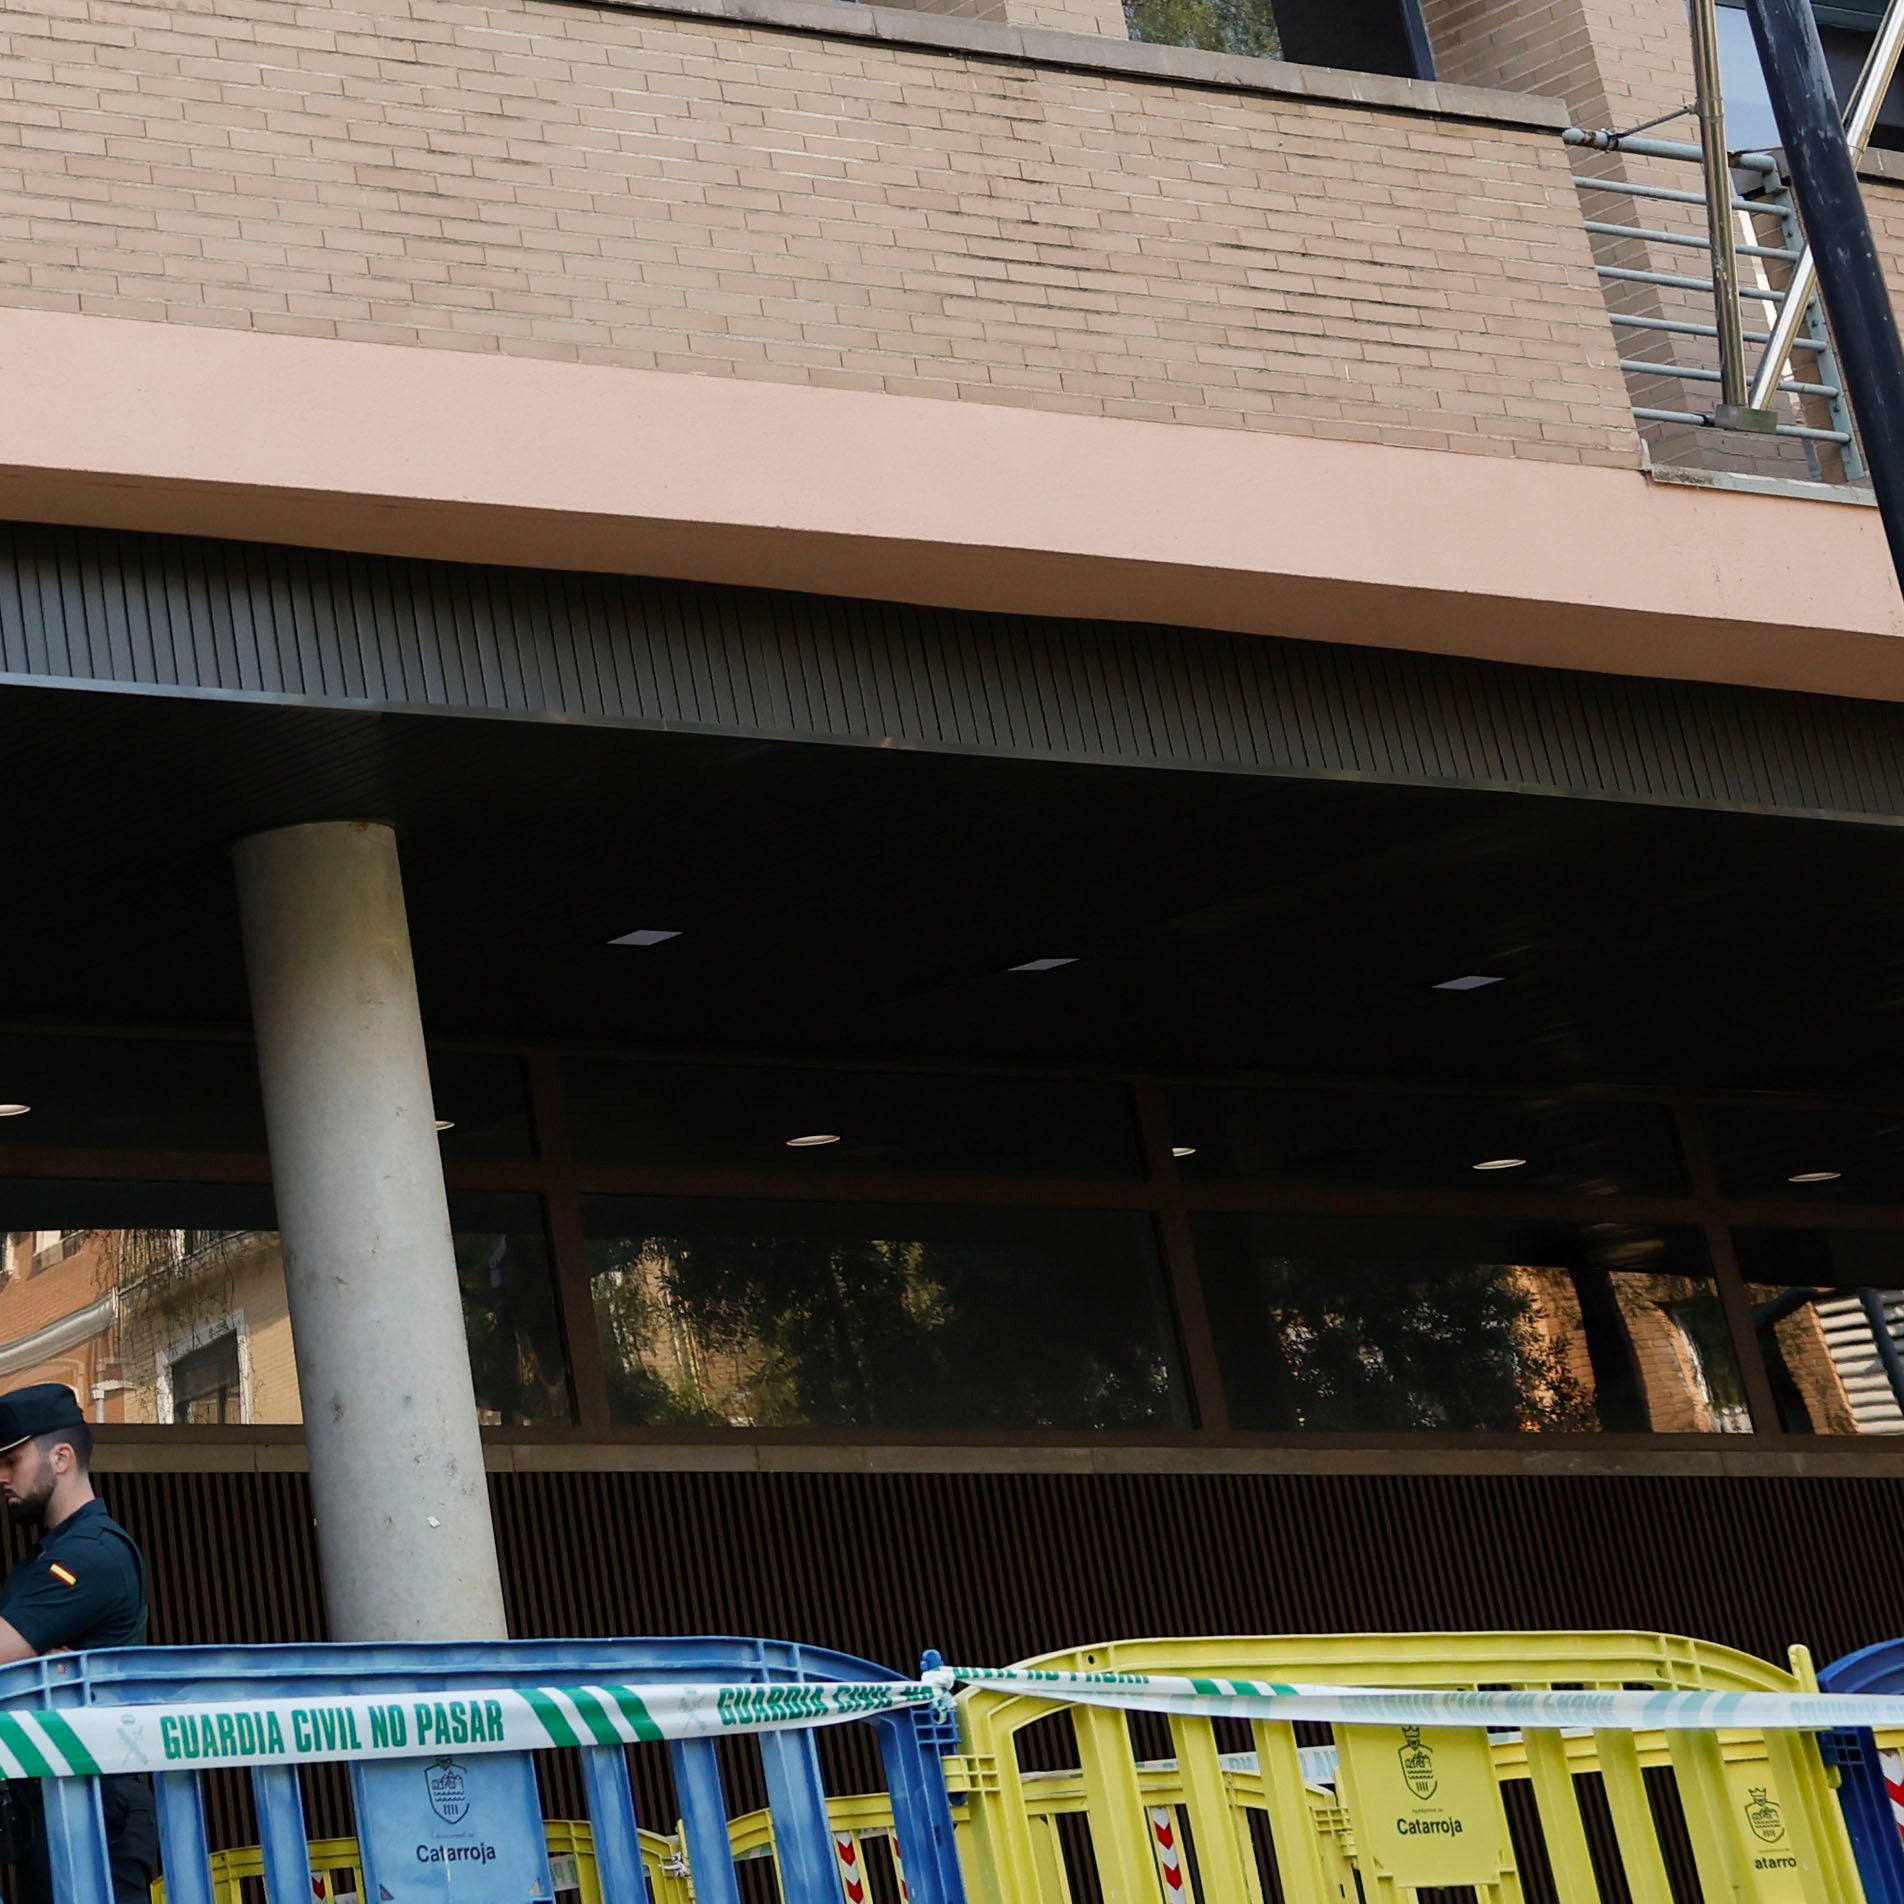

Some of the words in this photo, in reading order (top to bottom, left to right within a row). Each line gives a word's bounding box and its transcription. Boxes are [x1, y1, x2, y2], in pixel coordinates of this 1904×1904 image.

[717, 1685, 829, 1726] GUARDIA
[160, 1710, 286, 1760] GUARDIA
[291, 1706, 362, 1753] CIVIL
[368, 1704, 407, 1749] NO
[413, 1699, 505, 1746] PASAR
[1396, 1816, 1463, 1837] Catarroja
[416, 1842, 497, 1865] Catarroja
